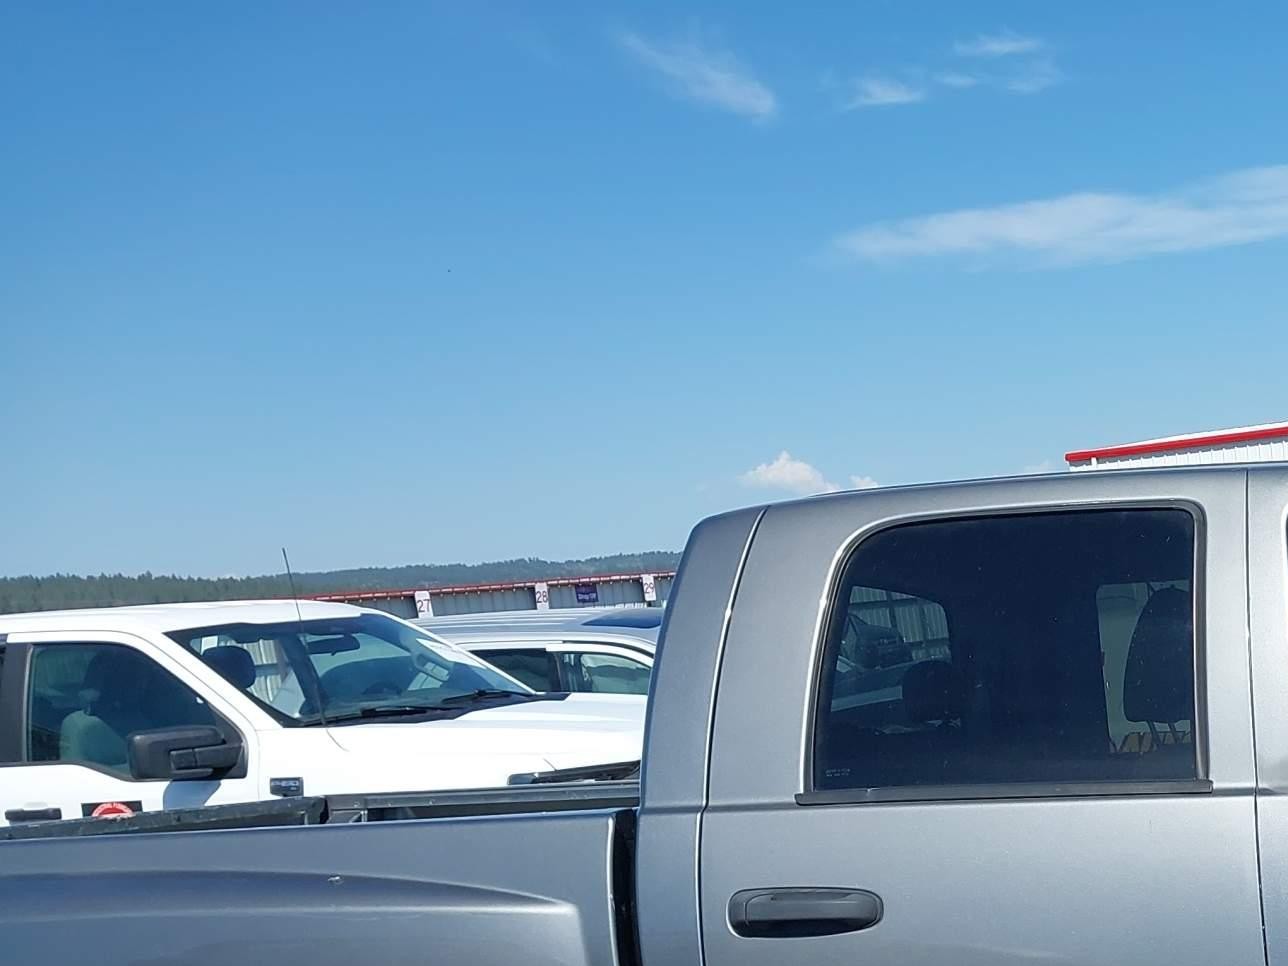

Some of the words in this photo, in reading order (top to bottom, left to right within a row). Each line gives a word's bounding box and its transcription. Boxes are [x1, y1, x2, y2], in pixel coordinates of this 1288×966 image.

[643, 582, 655, 594] 29
[535, 590, 549, 603] 28
[416, 598, 431, 613] 27
